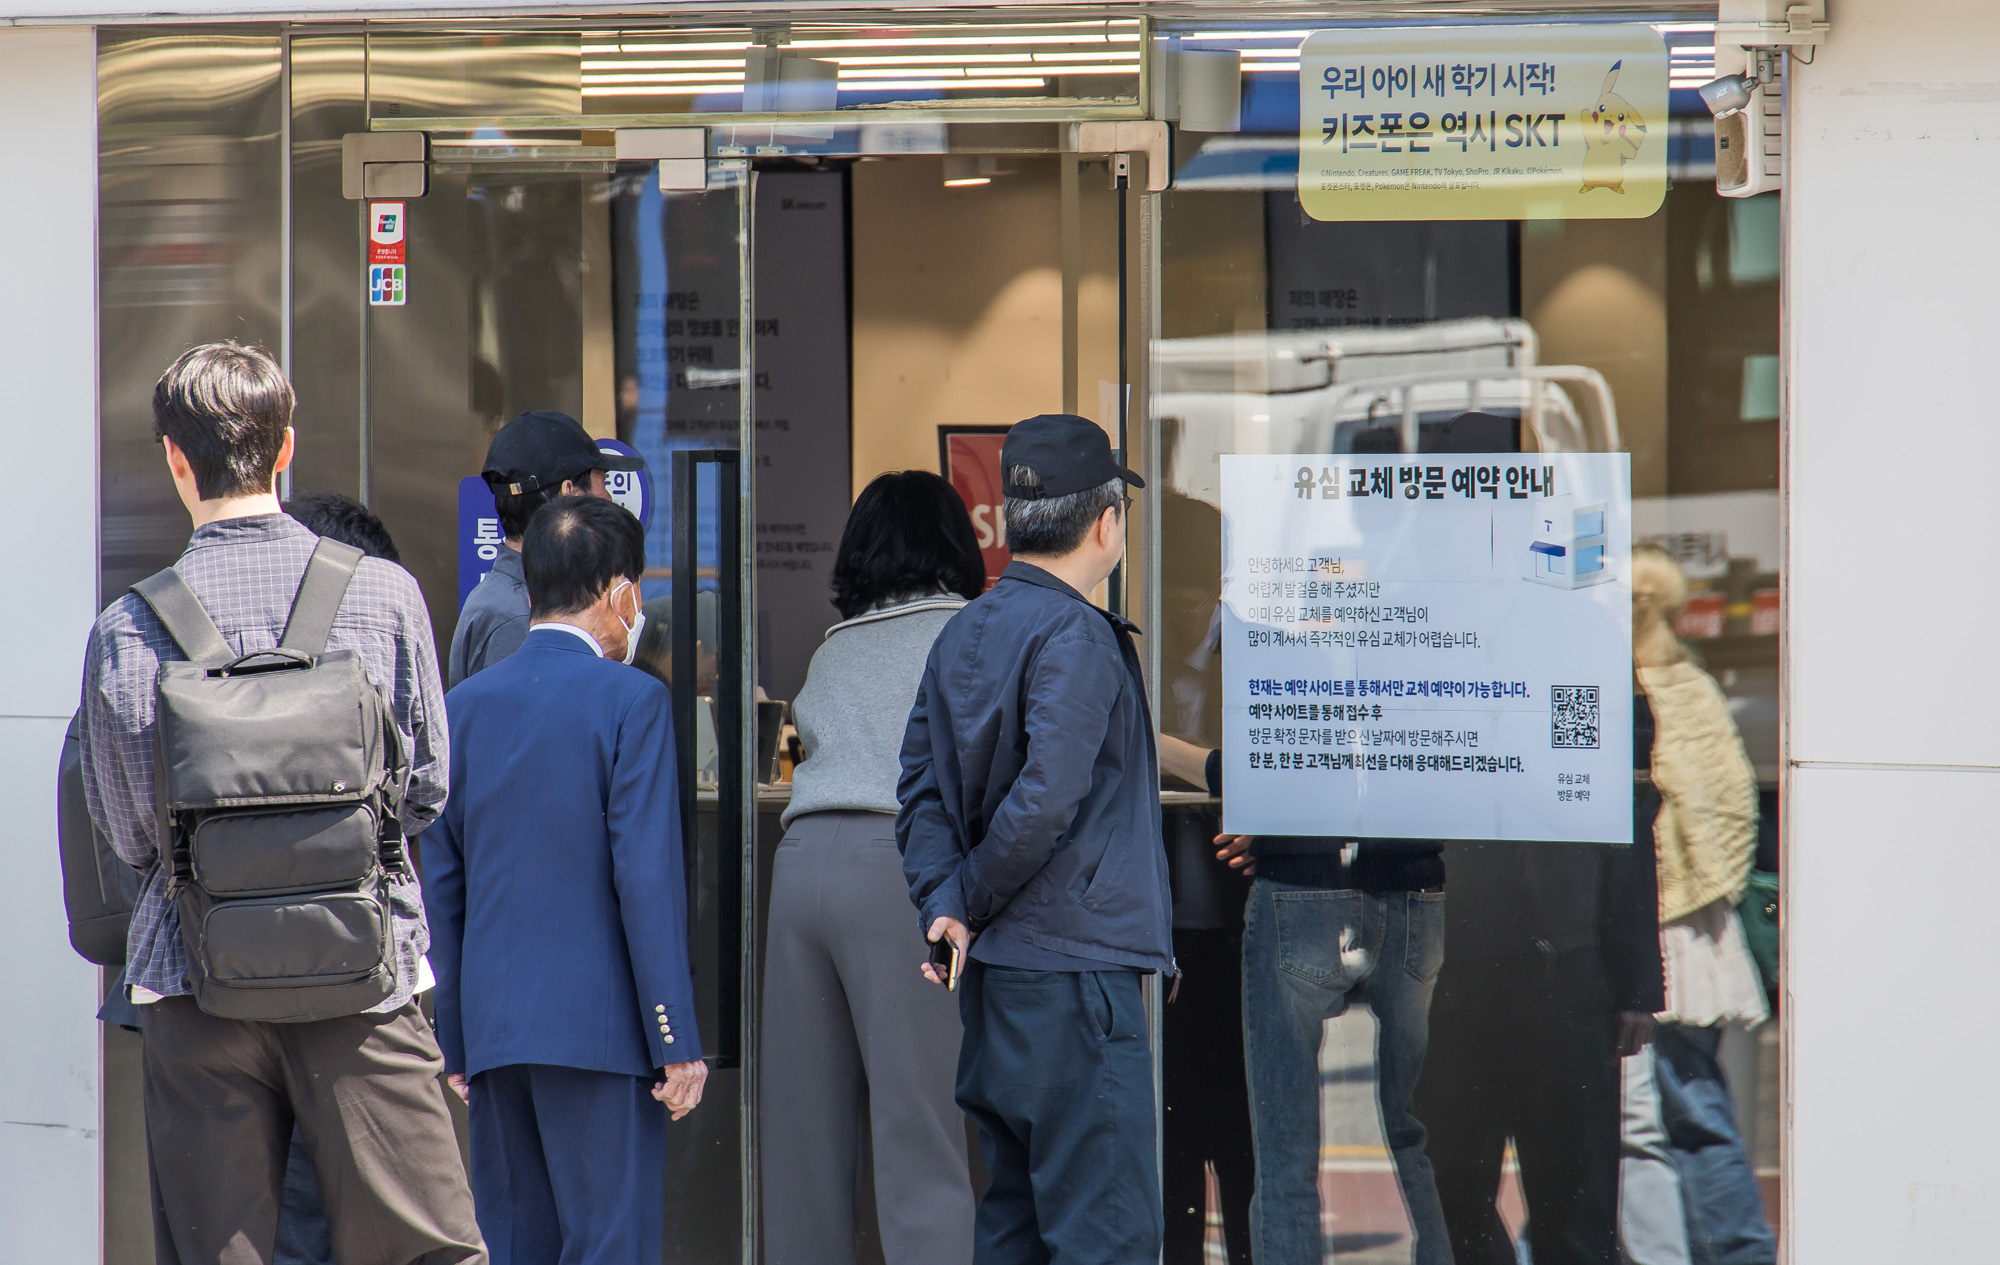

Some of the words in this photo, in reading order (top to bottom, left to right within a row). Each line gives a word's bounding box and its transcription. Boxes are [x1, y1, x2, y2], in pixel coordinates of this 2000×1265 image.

[1321, 65, 1365, 100] 우리
[1372, 64, 1416, 98] 아이
[1423, 64, 1445, 97] 새
[1451, 62, 1496, 97] 학기
[1503, 62, 1556, 96] 시작!
[1322, 111, 1434, 154] 키즈폰은
[1441, 110, 1496, 152] 역시
[1504, 113, 1566, 148] SKT
[1358, 168, 1390, 177] Creatures,
[1391, 168, 1410, 176] GAME
[1410, 168, 1433, 177] FREAK,
[1434, 168, 1443, 176] TV
[1444, 167, 1465, 177] Tokyo,
[1465, 167, 1491, 176] ShoPro,
[1492, 167, 1500, 175] JR
[1375, 181, 1411, 191] Pokémon은
[1412, 181, 1447, 191] Nintendo의
[371, 278, 403, 291] JCB
[1295, 466, 1340, 499] 유심
[1347, 466, 1393, 499] 교체
[1400, 466, 1447, 499] 방문
[1451, 466, 1500, 499] 예약
[1505, 465, 1554, 499] 안내
[1248, 557, 1305, 573] 안녕하세요
[1307, 557, 1344, 575] 고객님,
[1248, 581, 1283, 598] 어렵게
[1285, 581, 1319, 598] 발걸음
[1320, 581, 1332, 598] 해
[1334, 581, 1380, 598] 주셨지만
[1248, 606, 1270, 622] 이미
[1273, 606, 1295, 622] 유심
[1298, 606, 1332, 623] 교체를
[1334, 606, 1380, 623] 예약하신
[1382, 606, 1428, 623] 고객님이
[1248, 630, 1270, 647] 많이
[1273, 630, 1307, 647] 계셔서
[1310, 630, 1355, 647] 즉각적인
[1357, 630, 1380, 647] 유심
[1382, 630, 1417, 648] 교체가
[1419, 631, 1481, 649] 어렵습니다.
[1249, 679, 1283, 696] 현재는
[1285, 679, 1307, 696] 예약
[1309, 679, 1356, 697] 사이트를
[1358, 680, 1404, 697] 통해서만
[1405, 680, 1429, 697] 교체
[1431, 680, 1466, 698] 예약이
[1467, 680, 1530, 698] 가능합니다.
[1249, 703, 1272, 720] 예약
[1274, 703, 1320, 721] 사이트를
[1321, 703, 1344, 721] 통해
[1346, 703, 1369, 721] 접수
[1371, 703, 1383, 721] 후
[1249, 727, 1272, 745] 방문
[1274, 727, 1296, 745] 확정
[1298, 728, 1333, 745] 문자를
[1335, 728, 1370, 746] 받으신
[1372, 729, 1406, 746] 날짜에
[1408, 729, 1478, 747] 방문해주시면
[1306, 752, 1354, 770] 고객님께
[1356, 753, 1388, 770] 최선을
[1390, 753, 1414, 771] 다해
[1415, 754, 1524, 773] 응대해드리겠습니다.
[1557, 773, 1573, 785] 유심
[1575, 773, 1590, 785] 교체
[1557, 789, 1573, 802] 방문
[1574, 789, 1590, 802] 예약
